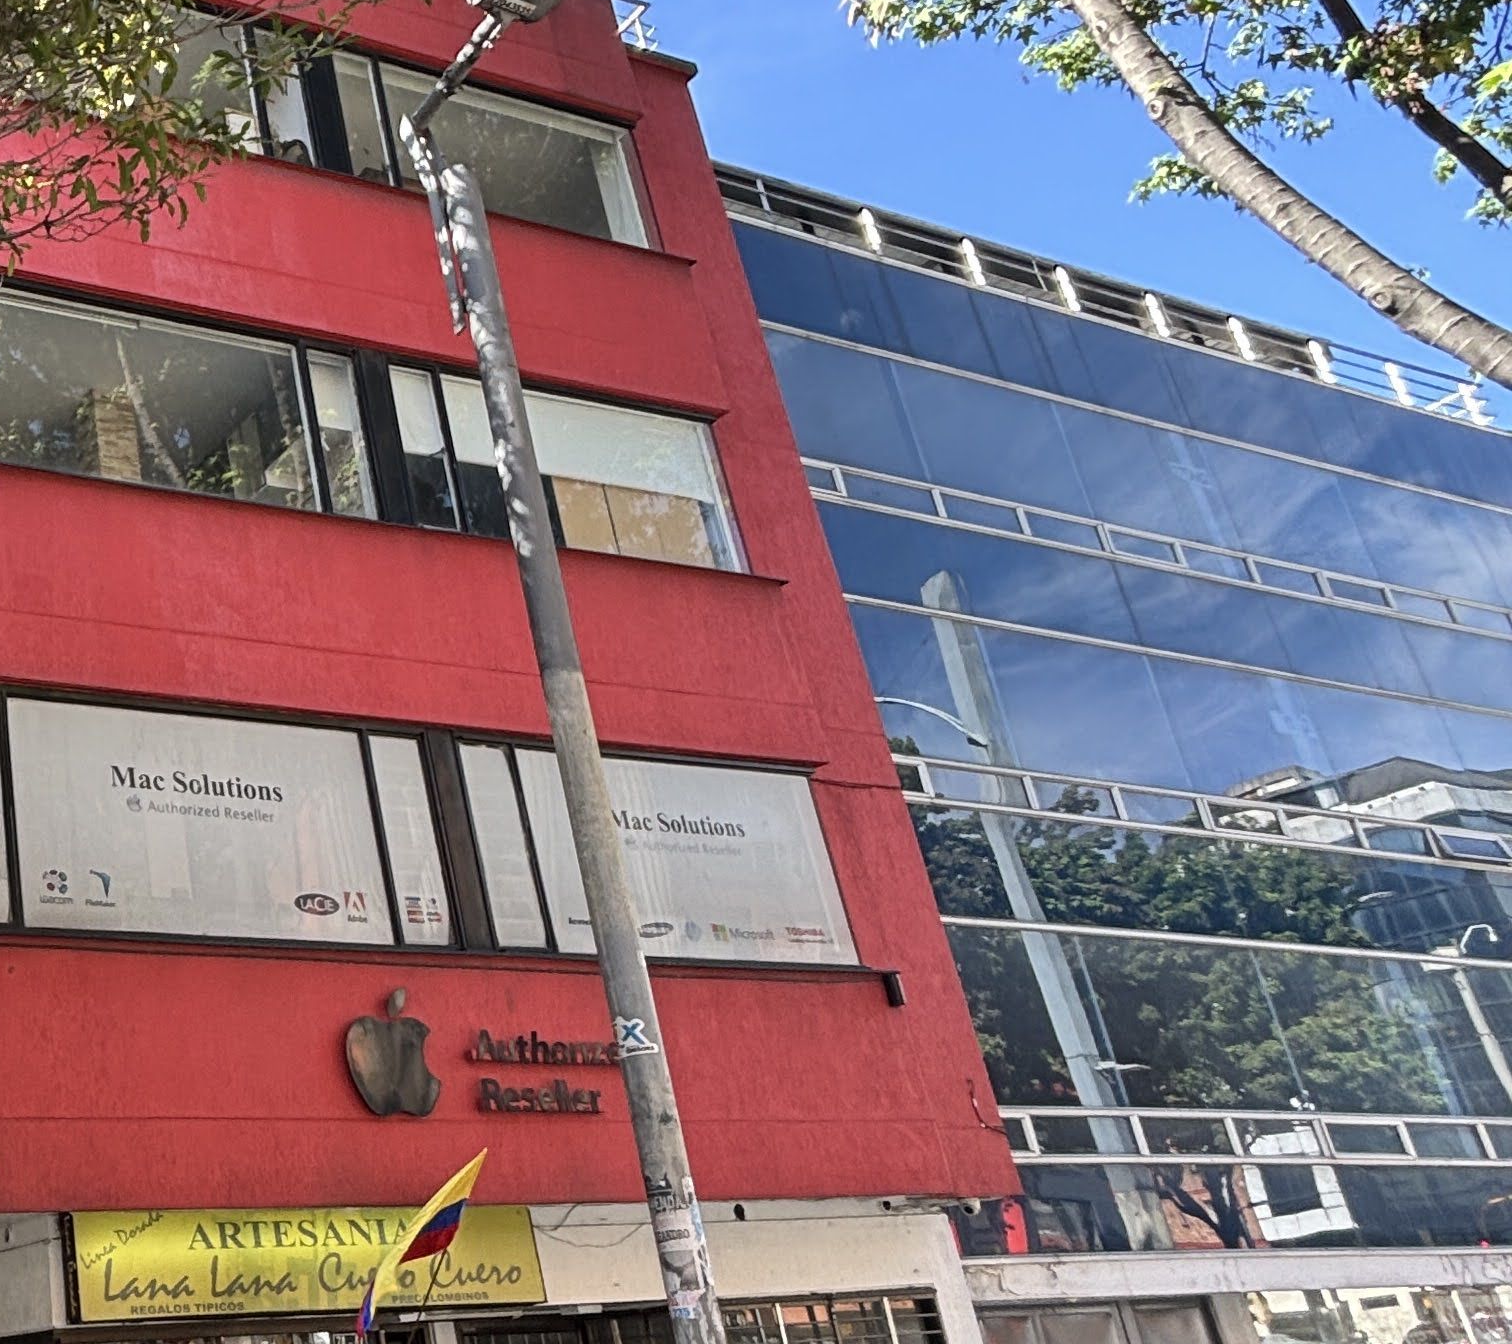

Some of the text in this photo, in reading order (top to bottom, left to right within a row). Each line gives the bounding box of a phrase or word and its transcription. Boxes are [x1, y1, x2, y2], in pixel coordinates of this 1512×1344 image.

[110, 765, 284, 803] Mac Solutions
[147, 800, 275, 823] Authorized Reseller
[611, 809, 746, 837] Mac Solutions
[476, 1028, 622, 1067] Authorize
[478, 1077, 603, 1114] Reseller
[188, 1219, 409, 1251] ARTESANIA
[103, 1257, 196, 1302] Lana
[210, 1255, 298, 1298] Lana
[318, 1252, 416, 1293] Cueo
[429, 1248, 522, 1289] Cuero
[130, 1301, 246, 1316] REGALOS TIPICOS
